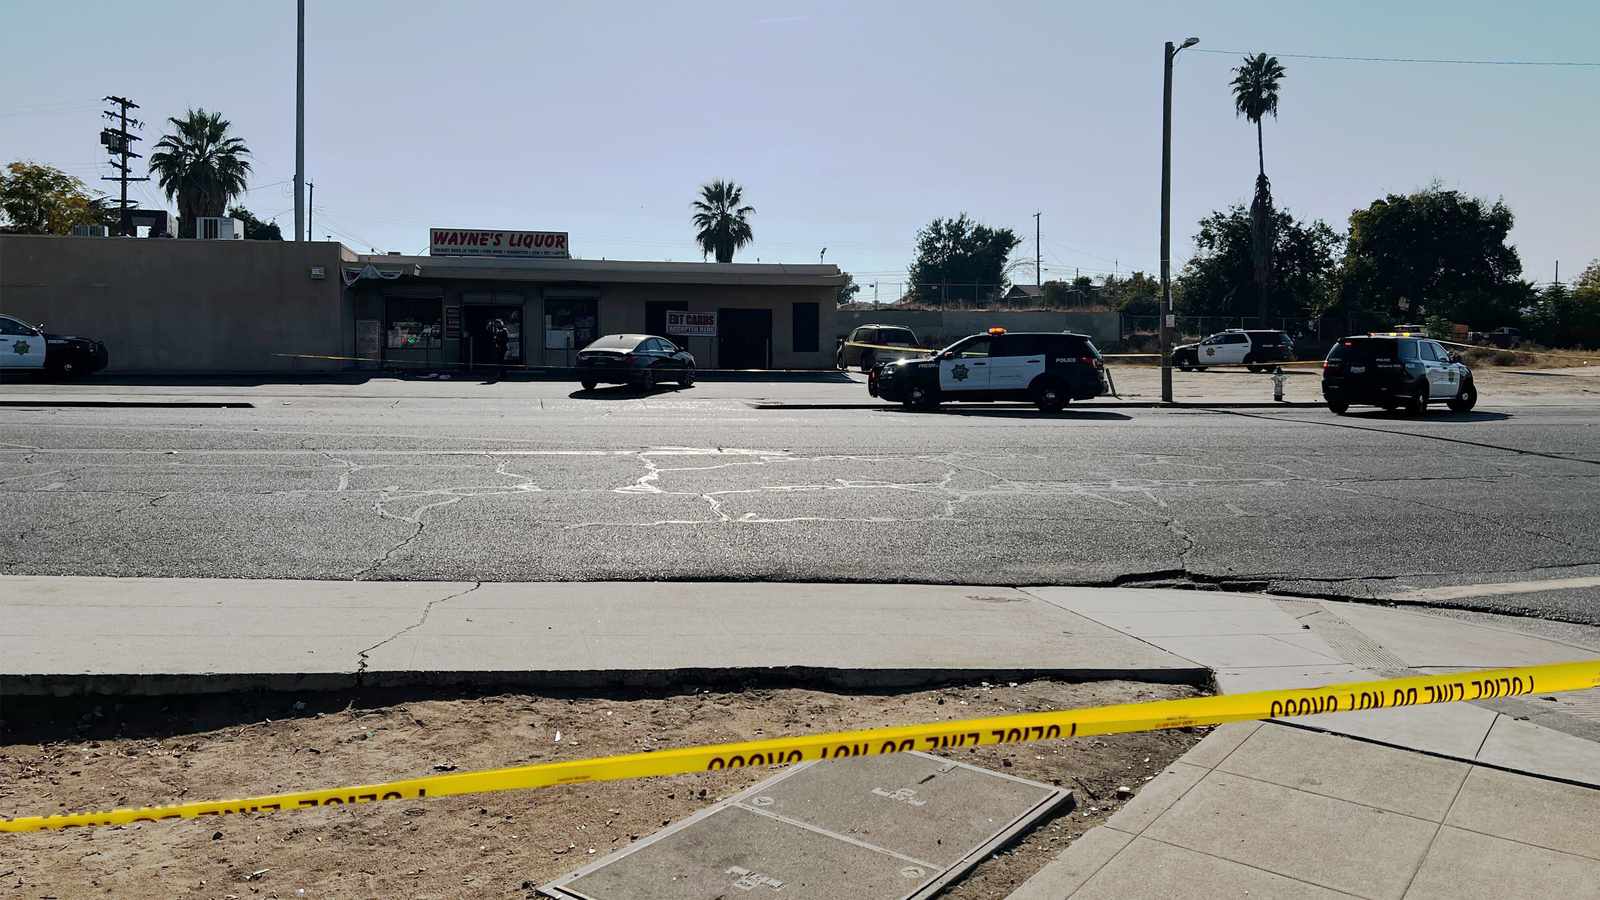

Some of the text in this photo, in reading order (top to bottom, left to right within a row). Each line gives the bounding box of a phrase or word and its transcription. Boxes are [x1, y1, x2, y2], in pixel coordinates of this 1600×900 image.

[433, 231, 566, 249] WAYNE'S LIQUOR
[669, 314, 714, 326] EBT CARDS
